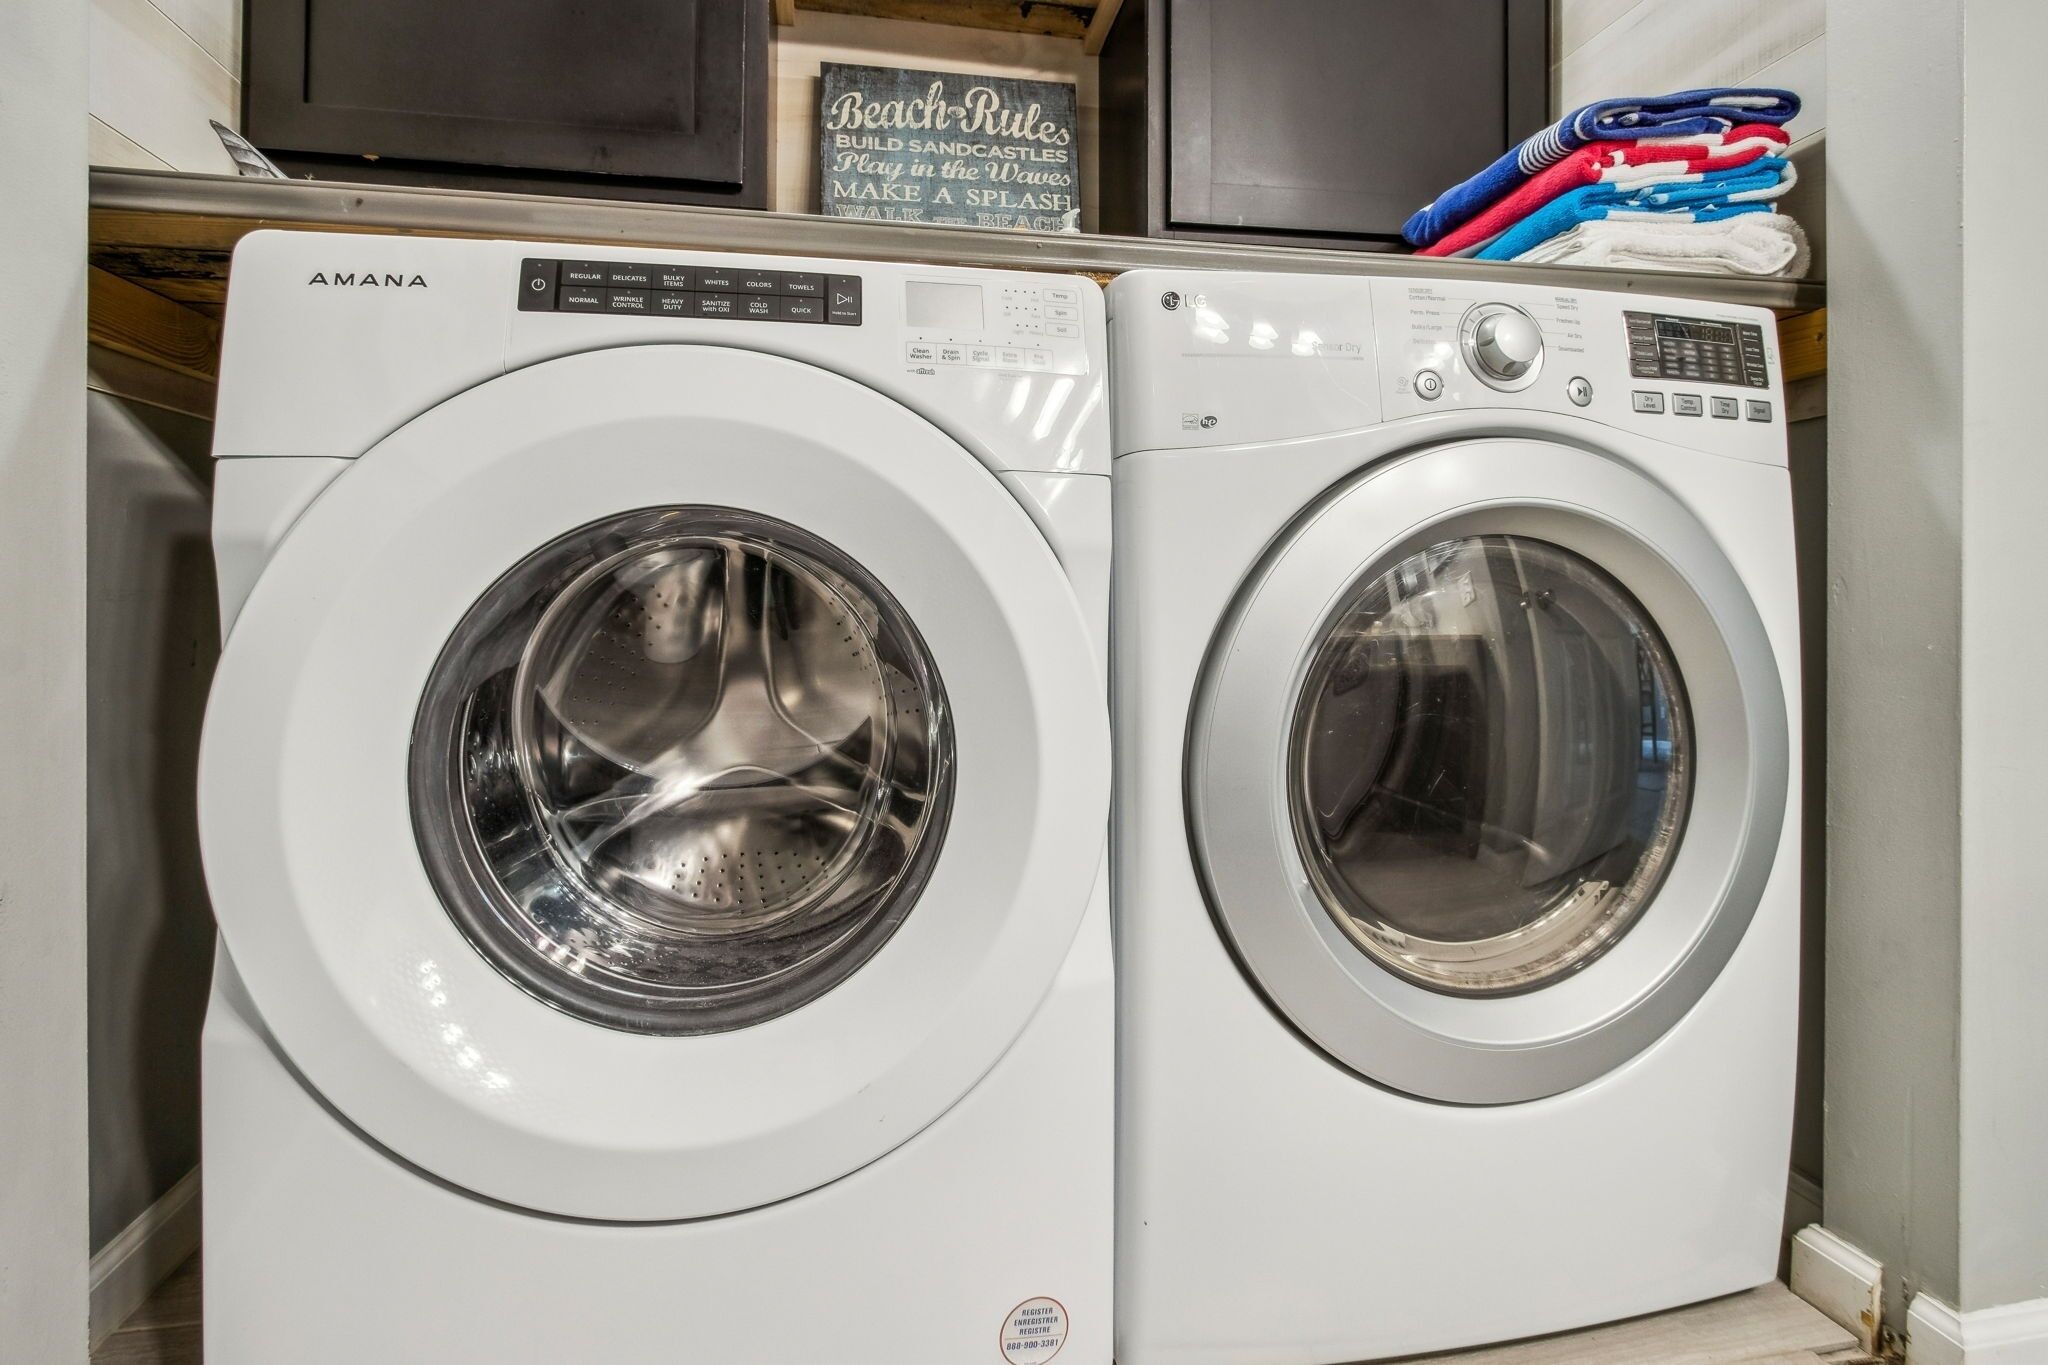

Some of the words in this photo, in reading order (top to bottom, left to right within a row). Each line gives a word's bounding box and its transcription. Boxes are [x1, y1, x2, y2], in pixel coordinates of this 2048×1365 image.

[826, 80, 951, 130] Beach
[960, 86, 1070, 146] Rules
[835, 134, 904, 151] BUILD
[909, 139, 1068, 163] SANDCASTLES
[832, 152, 905, 182] Play
[910, 158, 936, 178] in
[941, 160, 980, 181] the
[985, 161, 1071, 187] Waves
[833, 181, 922, 203] MAKE
[932, 187, 955, 204] A
[966, 188, 1072, 211] SPLASH
[836, 203, 924, 223] WALK
[308, 272, 428, 288] AMANA
[570, 272, 601, 280] REGULAR
[612, 274, 647, 282] DELICATES
[1184, 294, 1207, 308] LG
[1346, 342, 1361, 355] Dry
[1021, 1307, 1054, 1316] REGISTER
[1013, 1316, 1058, 1327] ENREGISTRER
[1019, 1326, 1051, 1336] REGISTRE
